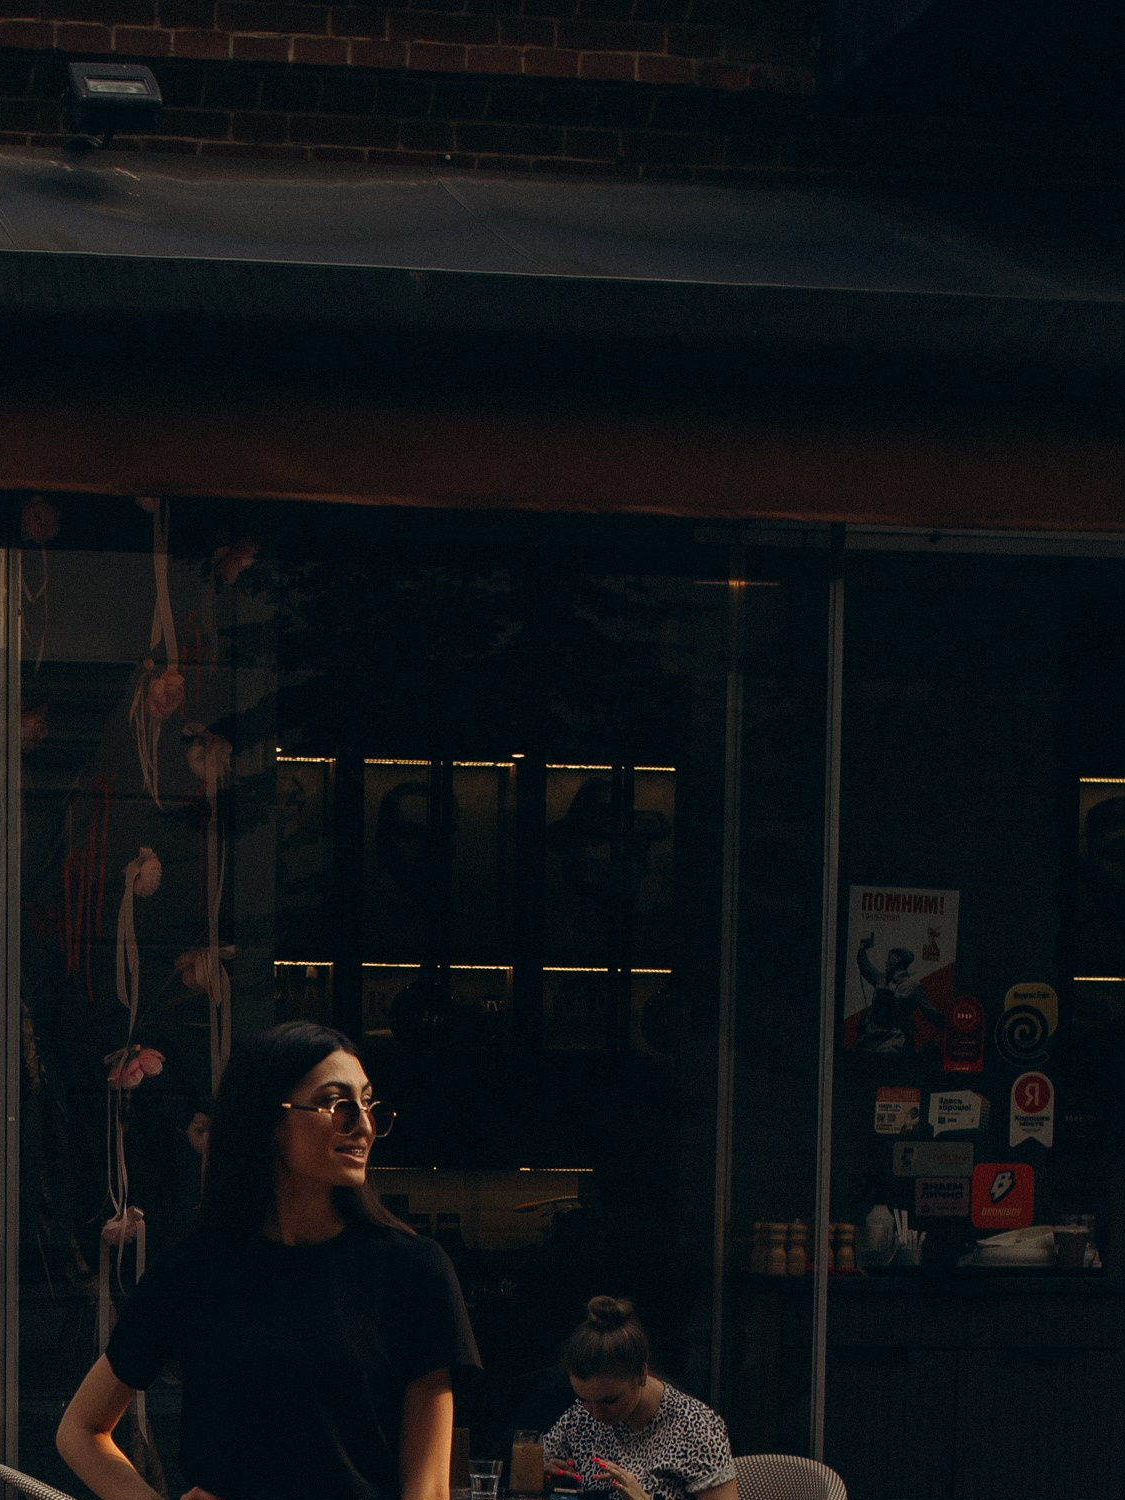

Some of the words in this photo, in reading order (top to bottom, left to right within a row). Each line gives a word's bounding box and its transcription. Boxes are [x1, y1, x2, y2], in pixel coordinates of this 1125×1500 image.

[861, 892, 945, 915] ПОМНИМ!
[1025, 1082, 1040, 1106] Я
[938, 1097, 963, 1105] Здесь
[938, 1104, 972, 1112] хорошо!
[922, 1182, 964, 1191] ЗНАЕМ
[921, 1191, 964, 1199] ЛИЧНО
[981, 1207, 1023, 1217] BRONIBOY
